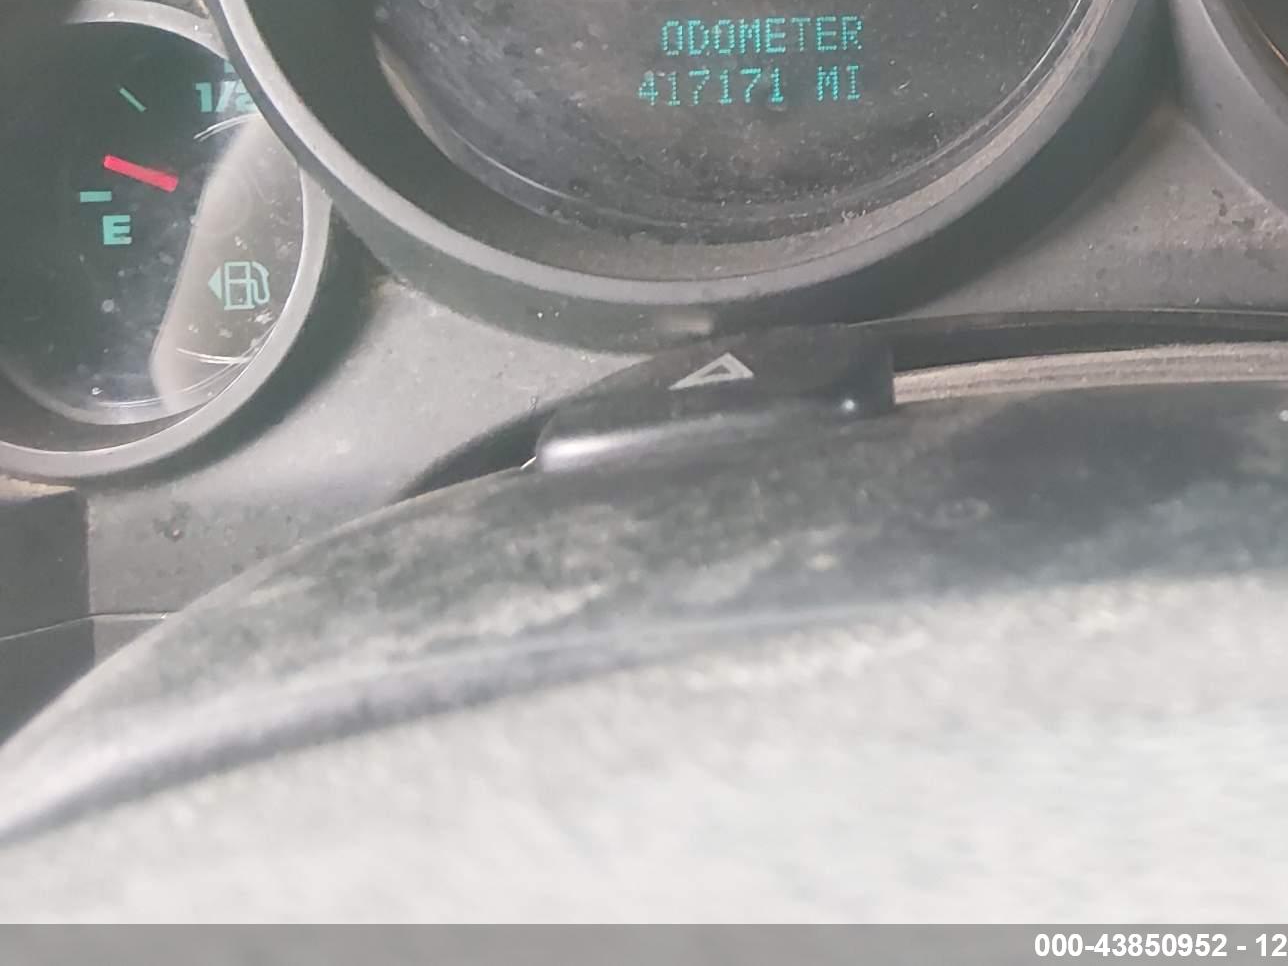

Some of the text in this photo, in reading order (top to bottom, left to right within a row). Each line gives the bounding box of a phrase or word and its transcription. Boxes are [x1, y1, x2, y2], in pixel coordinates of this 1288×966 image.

[661, 16, 862, 56] ODOMETER
[637, 65, 861, 107] 417171 MI
[102, 214, 132, 245] E
